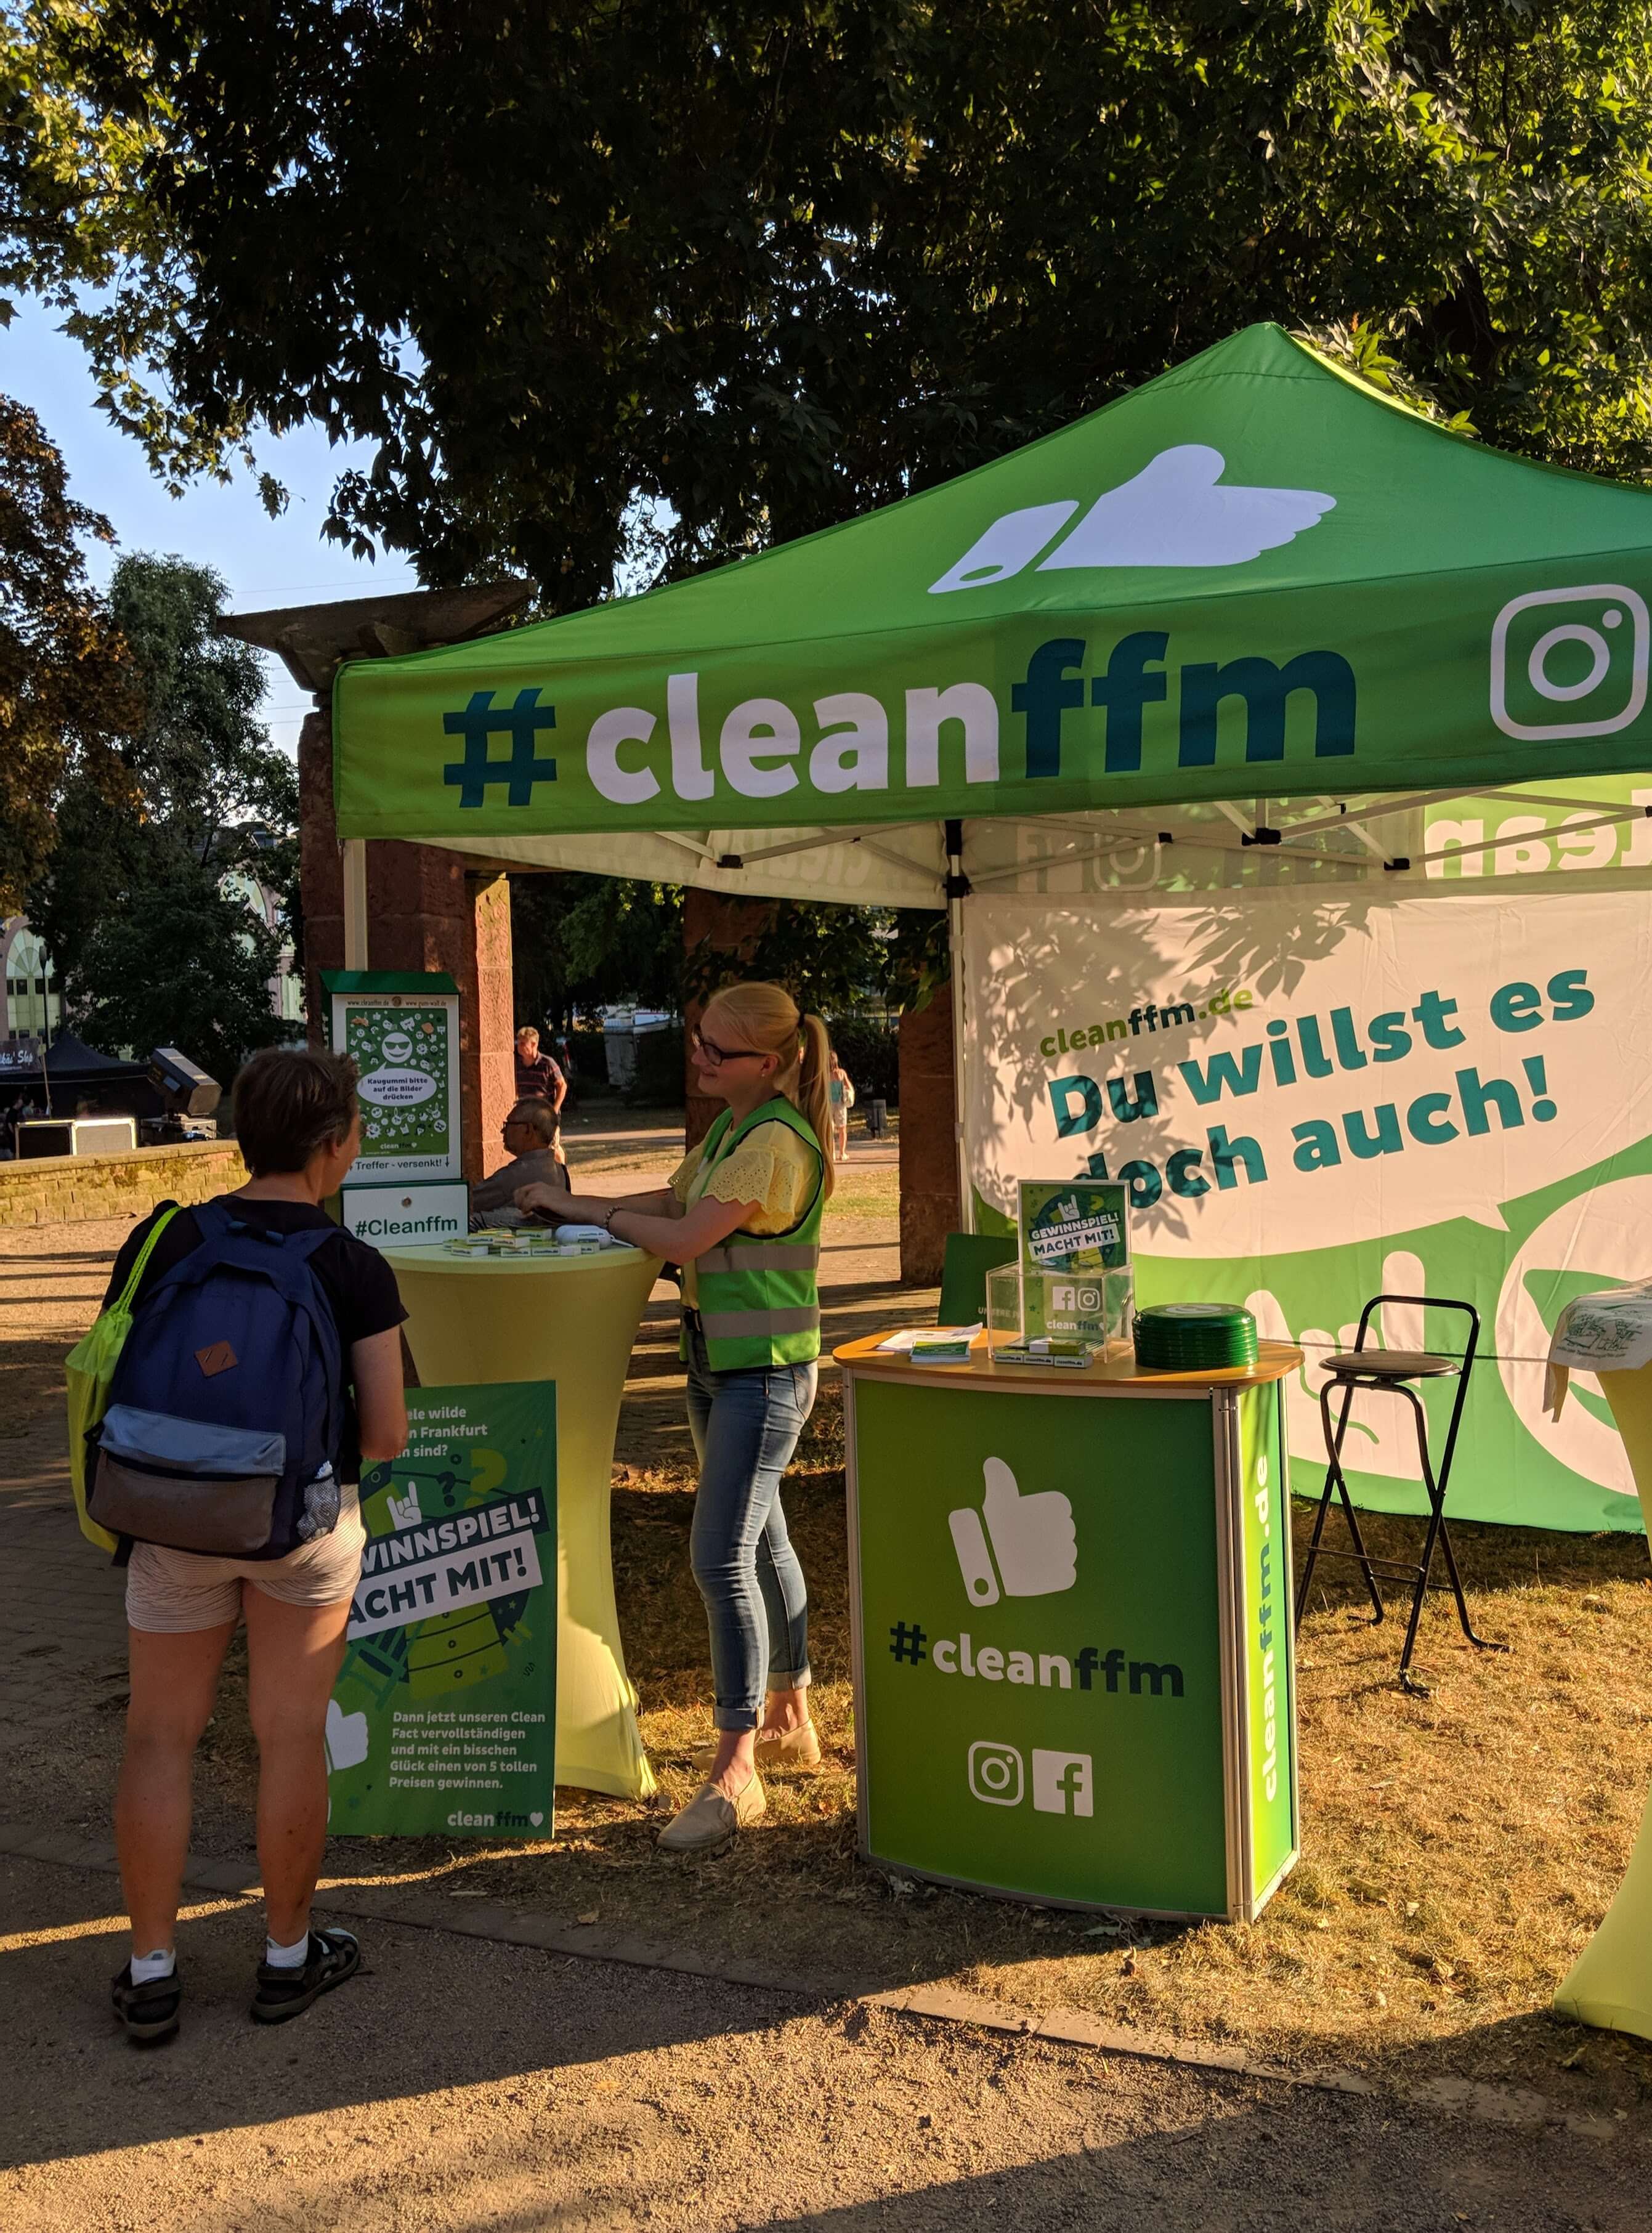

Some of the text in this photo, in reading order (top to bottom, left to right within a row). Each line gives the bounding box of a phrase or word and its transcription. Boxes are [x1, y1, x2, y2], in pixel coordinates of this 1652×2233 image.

[442, 630, 1356, 808] #cleanffm
[1039, 987, 1253, 1058] cleanffm.de
[1048, 969, 1595, 1139] Du willst es
[367, 1077, 408, 1085] Kaugummi
[1290, 1054, 1558, 1172] auch!
[355, 1161, 390, 1170] Treffer
[397, 1159, 442, 1169] versenkt!
[355, 1215, 458, 1236] #Cleanffm
[1031, 1212, 1120, 1240] GEWINNSPIEL!
[1034, 1228, 1115, 1257] MACHT MIT!
[1046, 1319, 1099, 1331] cleanffm
[428, 1406, 467, 1419] wilde
[420, 1424, 488, 1438] Frankfurt
[413, 1445, 448, 1457] sind?
[446, 1546, 527, 1597] MIT!
[1253, 1454, 1277, 1802] cleanffm.de
[889, 1621, 1184, 1698] #cleanffm
[393, 1711, 546, 1724] Dann jetzt unseren Clean
[392, 1728, 525, 1741] Fact vervollständigen
[391, 1744, 517, 1756] und mit ein bisschen
[390, 1761, 538, 1772] Glück einen von 5 tollen
[389, 1776, 503, 1790] Preisen gewinnen.
[447, 1810, 528, 1828] cleanffm
